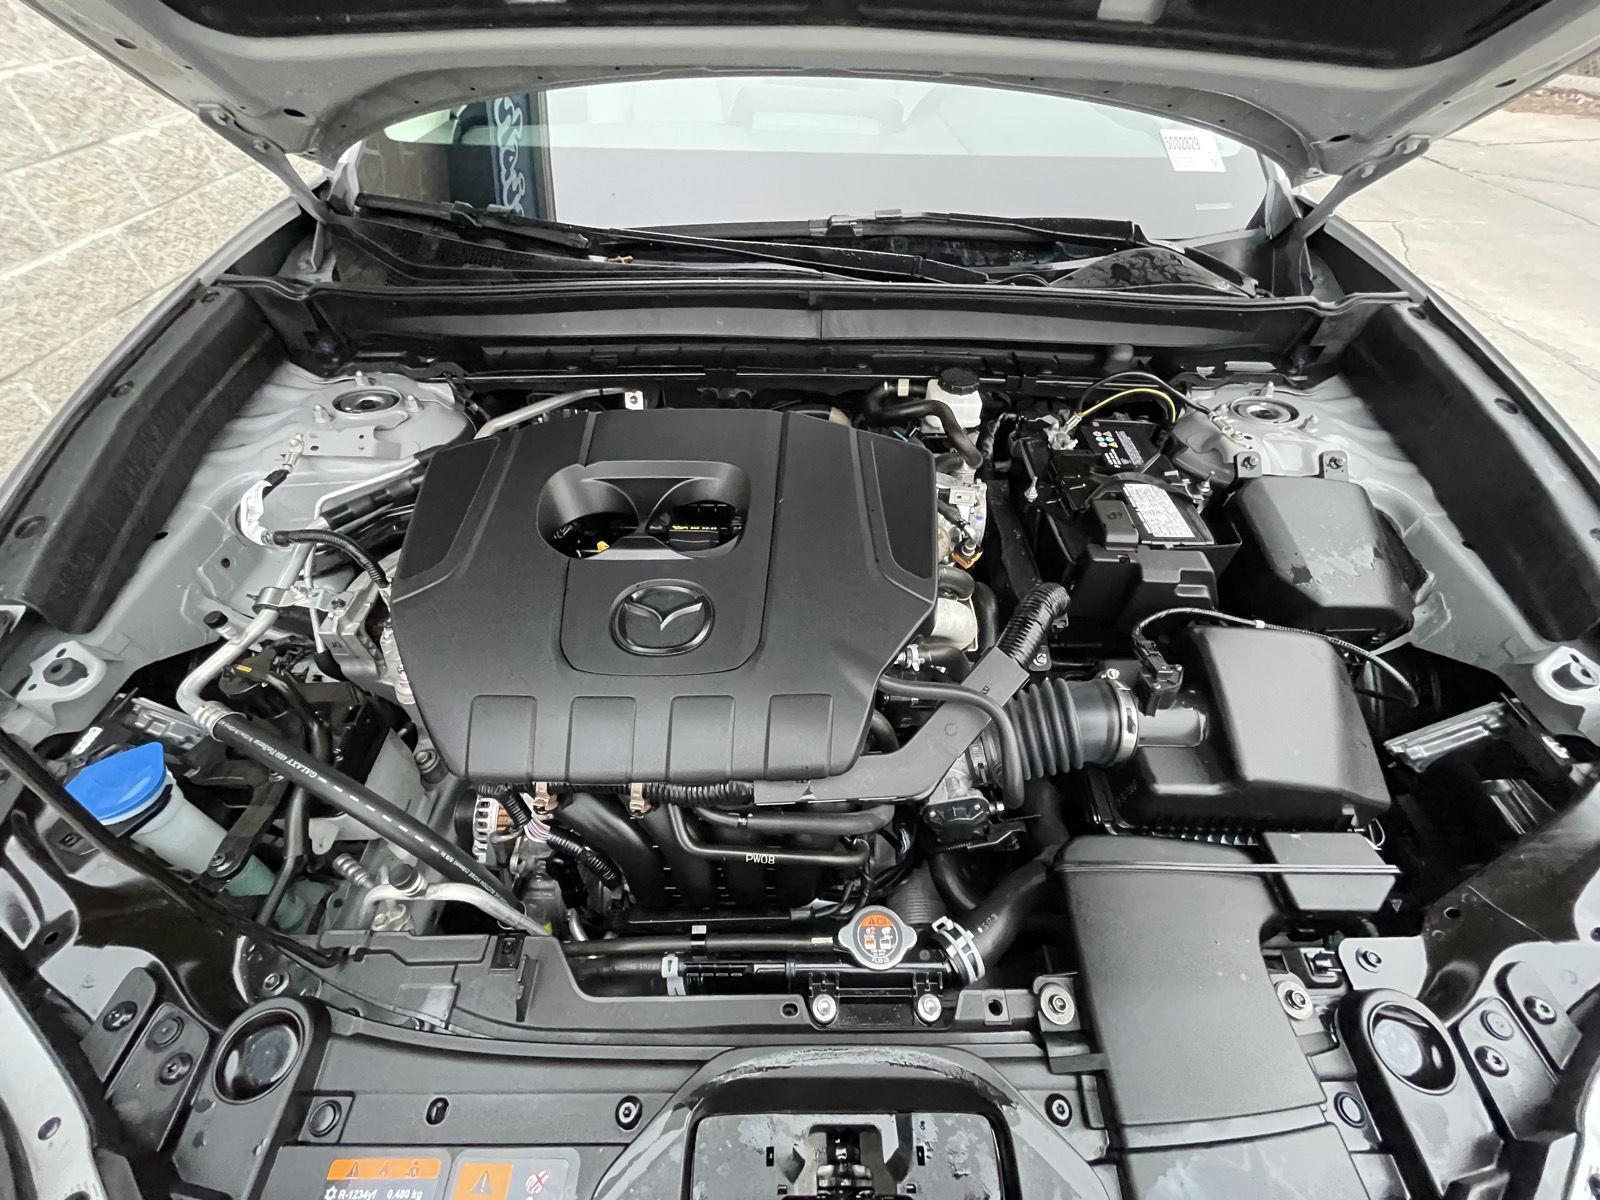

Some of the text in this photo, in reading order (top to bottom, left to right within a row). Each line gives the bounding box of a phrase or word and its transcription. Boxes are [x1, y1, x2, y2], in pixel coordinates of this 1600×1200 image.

[286, 759, 317, 778] GALAXY
[745, 853, 775, 864] PW08
[411, 1189, 423, 1200] kg
